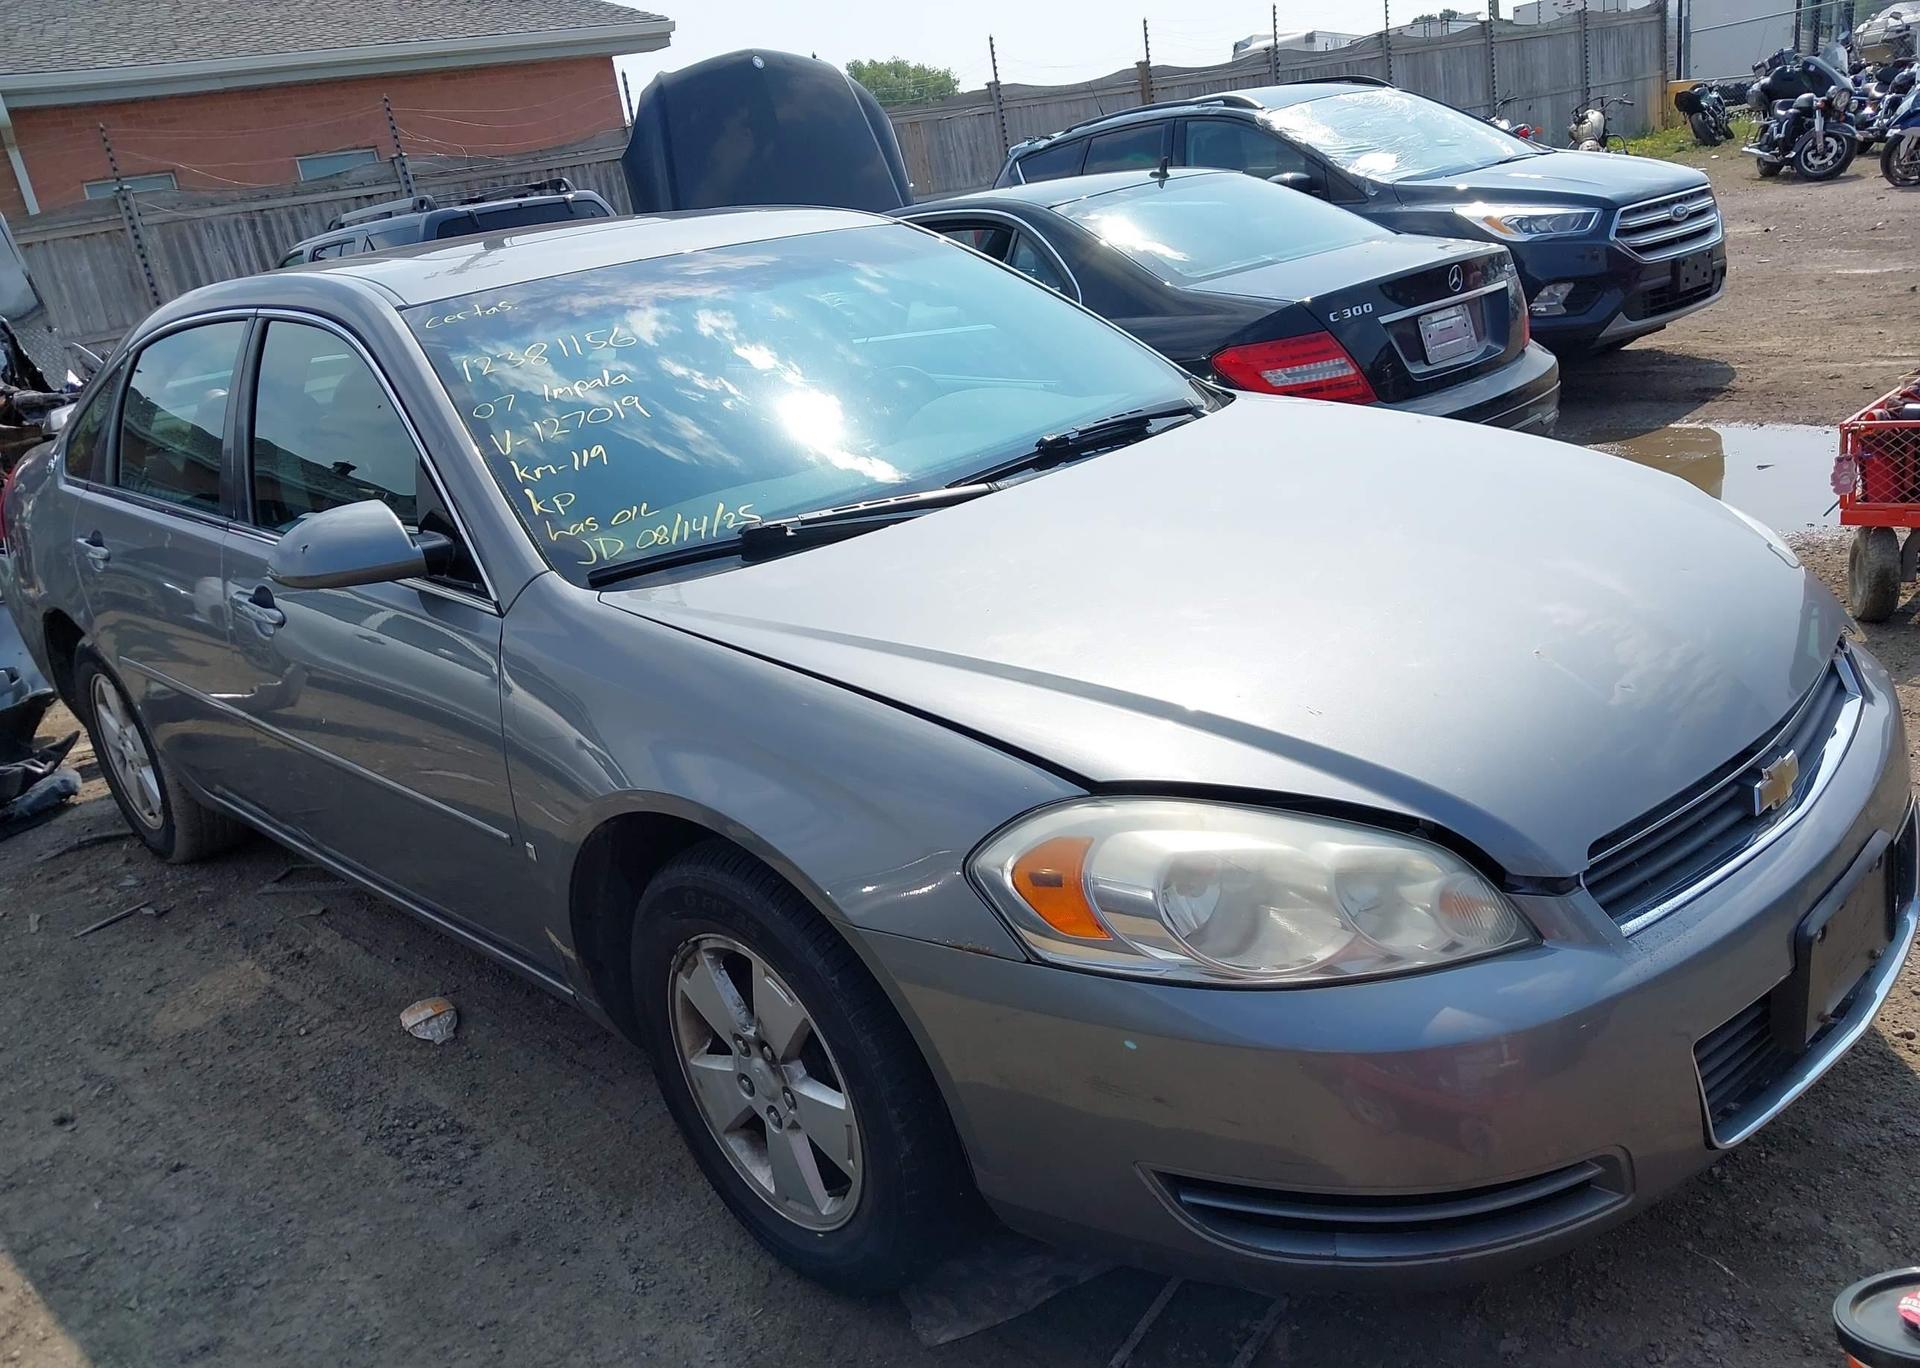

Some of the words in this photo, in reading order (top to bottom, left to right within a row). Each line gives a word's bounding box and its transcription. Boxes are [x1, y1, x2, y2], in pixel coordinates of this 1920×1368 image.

[1329, 311, 1341, 322] C
[1342, 303, 1373, 319] 300
[462, 327, 637, 382] 12381156
[473, 394, 515, 419] 07
[543, 369, 633, 402] Impala
[546, 517, 599, 541] has
[577, 537, 625, 565] JD
[635, 503, 762, 551] 08/14/25
